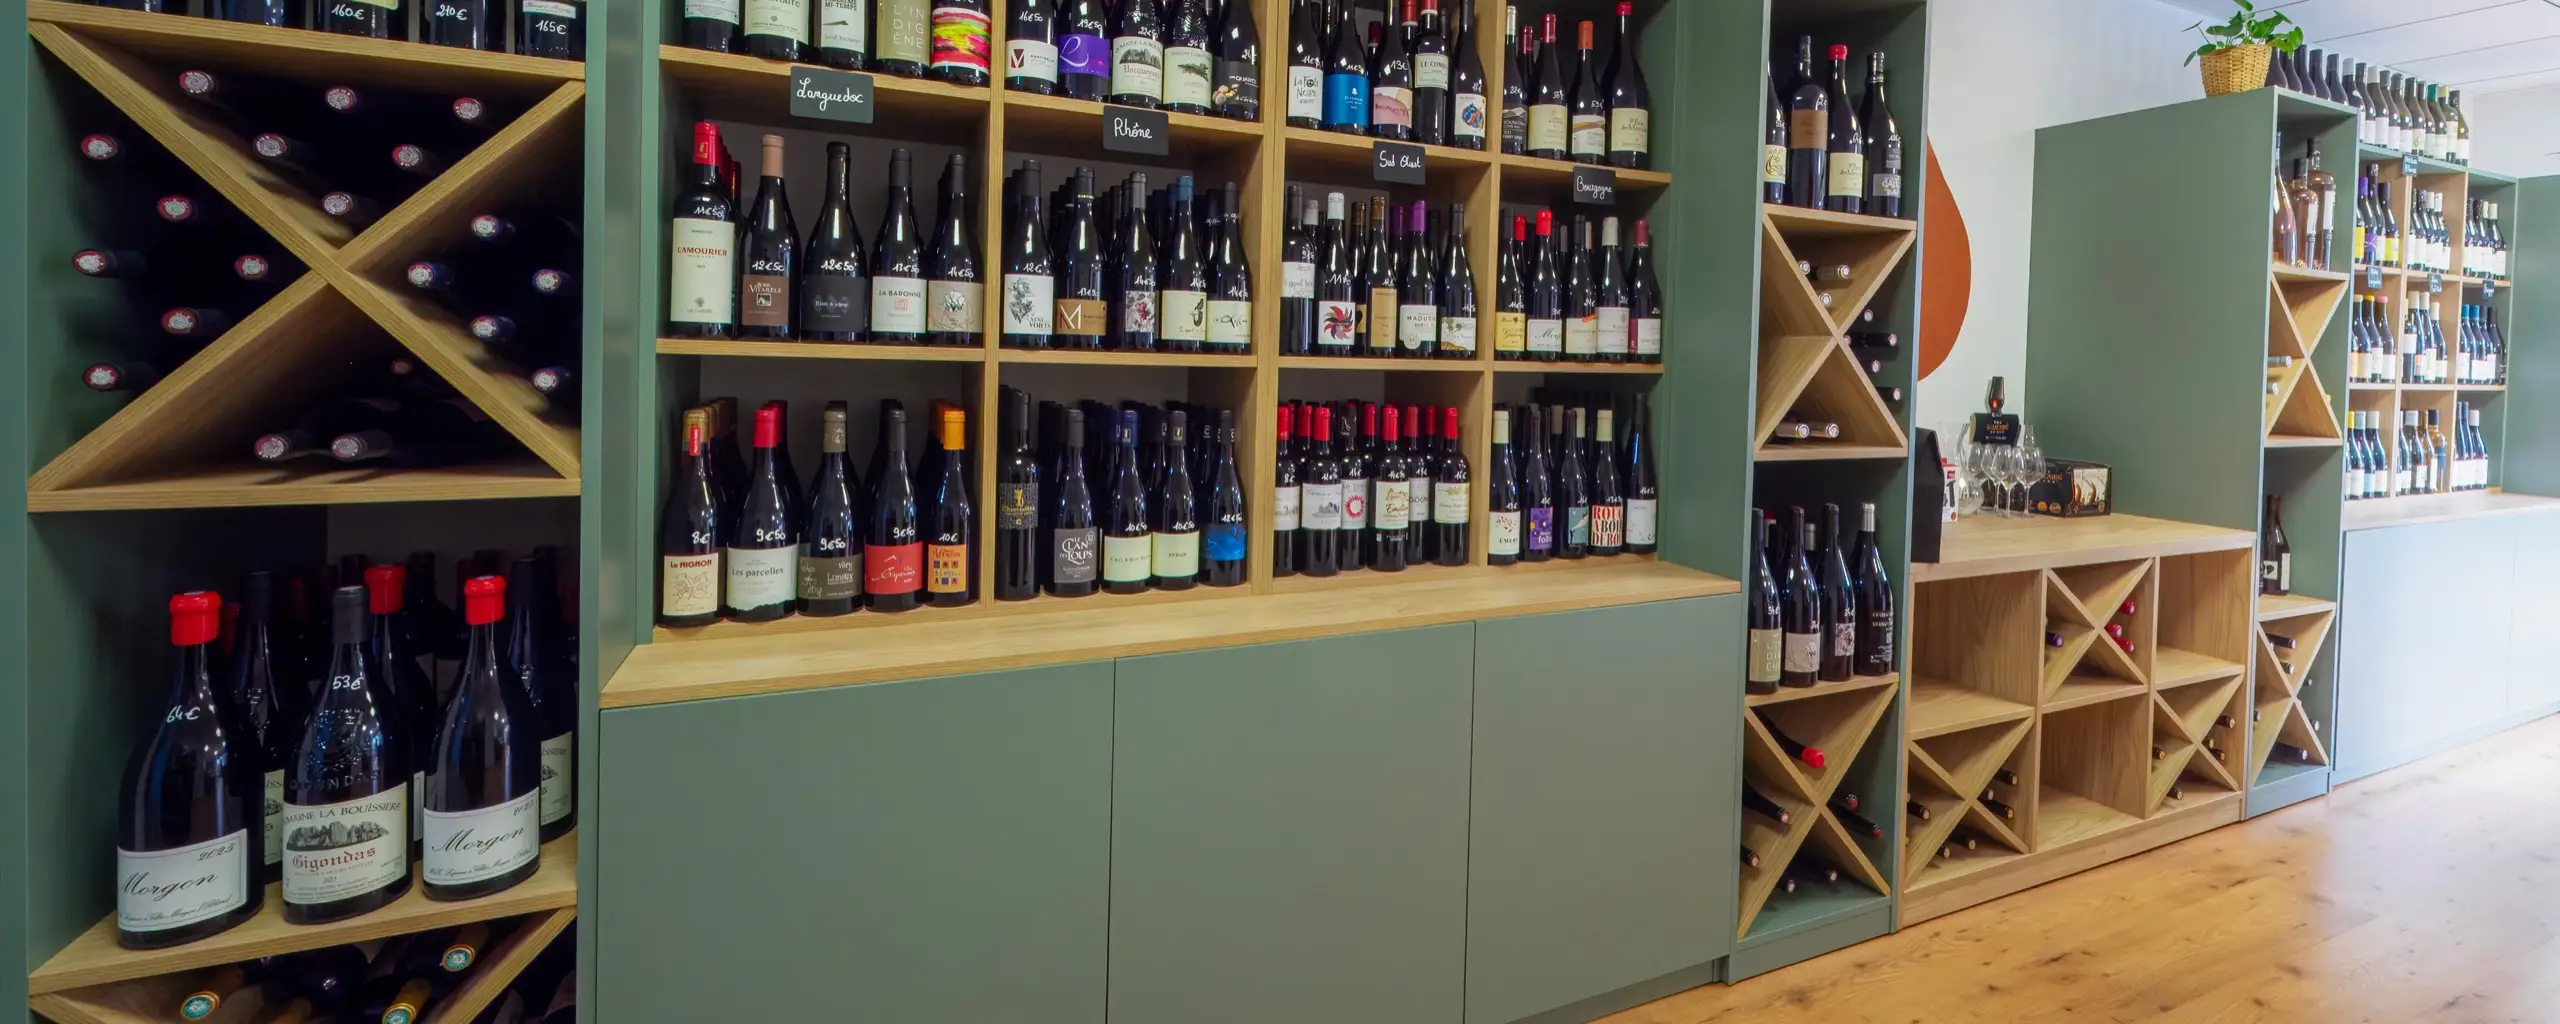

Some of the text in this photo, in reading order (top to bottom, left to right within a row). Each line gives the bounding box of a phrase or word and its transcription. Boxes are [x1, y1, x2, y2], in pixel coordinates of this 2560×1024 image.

[331, 4, 365, 20] 160€
[436, 4, 467, 20] 210€
[1019, 10, 1043, 22] 16€50
[536, 20, 566, 34] 165€
[796, 78, 864, 111] Languedoc
[1114, 118, 1152, 138] Rhône
[1380, 150, 1396, 168] Sud
[1576, 176, 1612, 200] Bourgogne
[694, 206, 724, 218] 11€50
[678, 246, 728, 256] L'AMOURIER
[752, 260, 785, 272] 12€50
[821, 258, 857, 271] 12€50
[892, 263, 920, 274] 13€50
[1023, 262, 1042, 273] 12€
[888, 290, 922, 298] BARONNE
[692, 531, 710, 544] 8€
[756, 528, 786, 542] 9€50
[894, 528, 915, 538] 9€50
[939, 532, 958, 542] 10€
[820, 538, 846, 550] 9€50
[1062, 538, 1089, 554] CLAN
[680, 559, 712, 568] MIGNON
[1068, 550, 1092, 565] LOUPS
[732, 566, 784, 578] Les parcelles
[332, 676, 364, 690] 53€
[166, 705, 200, 722] 64€
[320, 810, 336, 818] LA
[432, 827, 524, 856] Morgon
[292, 848, 376, 872] Gigondas
[120, 872, 218, 902] Morgon
